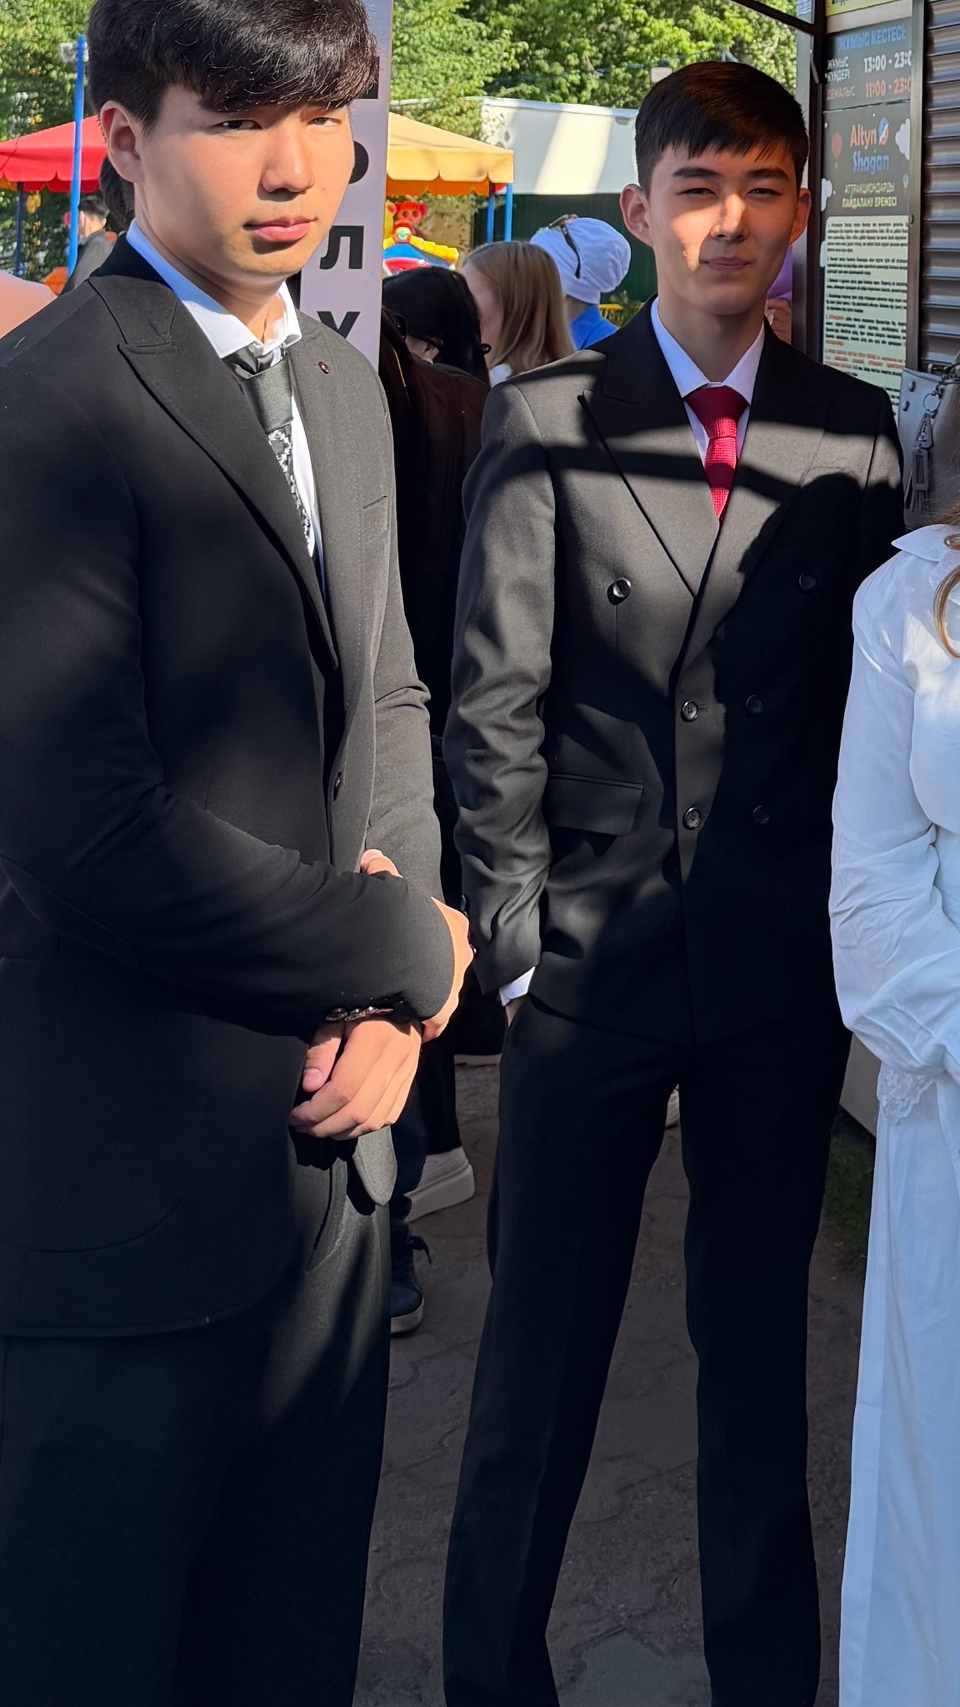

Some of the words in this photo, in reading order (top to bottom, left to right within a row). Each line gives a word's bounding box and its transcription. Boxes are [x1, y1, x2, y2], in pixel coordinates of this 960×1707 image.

[863, 54, 887, 73] 13:00
[865, 79, 887, 98] 11:00
[849, 124, 877, 150] Altyn
